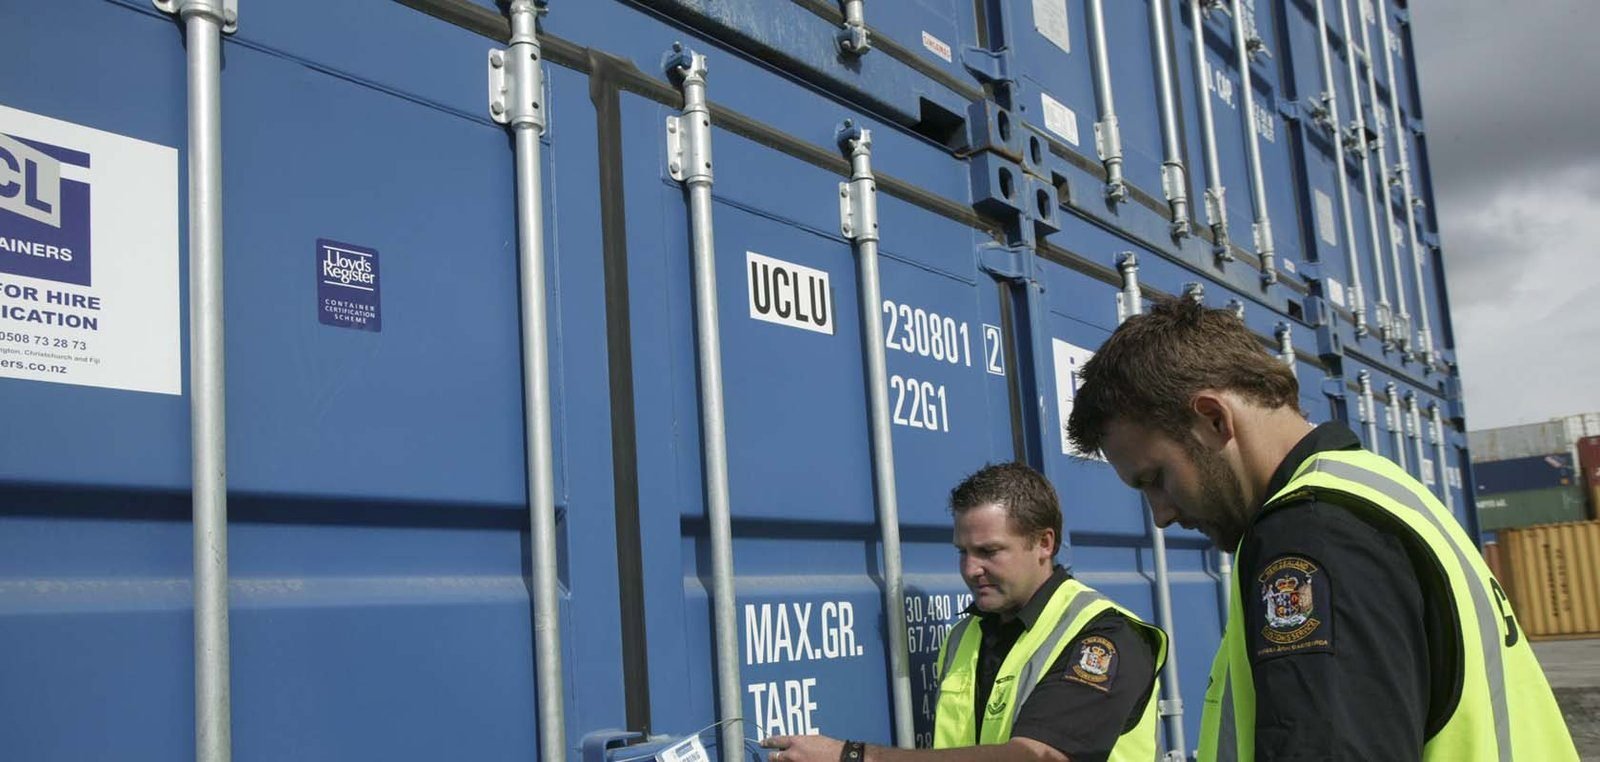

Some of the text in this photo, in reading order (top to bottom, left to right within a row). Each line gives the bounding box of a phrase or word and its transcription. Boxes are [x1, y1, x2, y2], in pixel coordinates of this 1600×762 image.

[323, 260, 375, 284] Register
[0, 283, 101, 310] OR HIRE
[324, 299, 375, 311] CONTAINER
[751, 260, 827, 327] UCLU
[2, 305, 98, 331] ICATION
[324, 306, 376, 319] CERTIFICATION
[334, 313, 367, 324] SCHEME
[0, 331, 87, 351] 0508 73 28 73
[883, 300, 1002, 373] 230801 2
[1, 359, 67, 374] ers.co.nz
[890, 375, 949, 432] 22G1
[905, 594, 951, 623] 30,480
[744, 601, 864, 665] MAX.GR.
[748, 677, 820, 744] TARE
